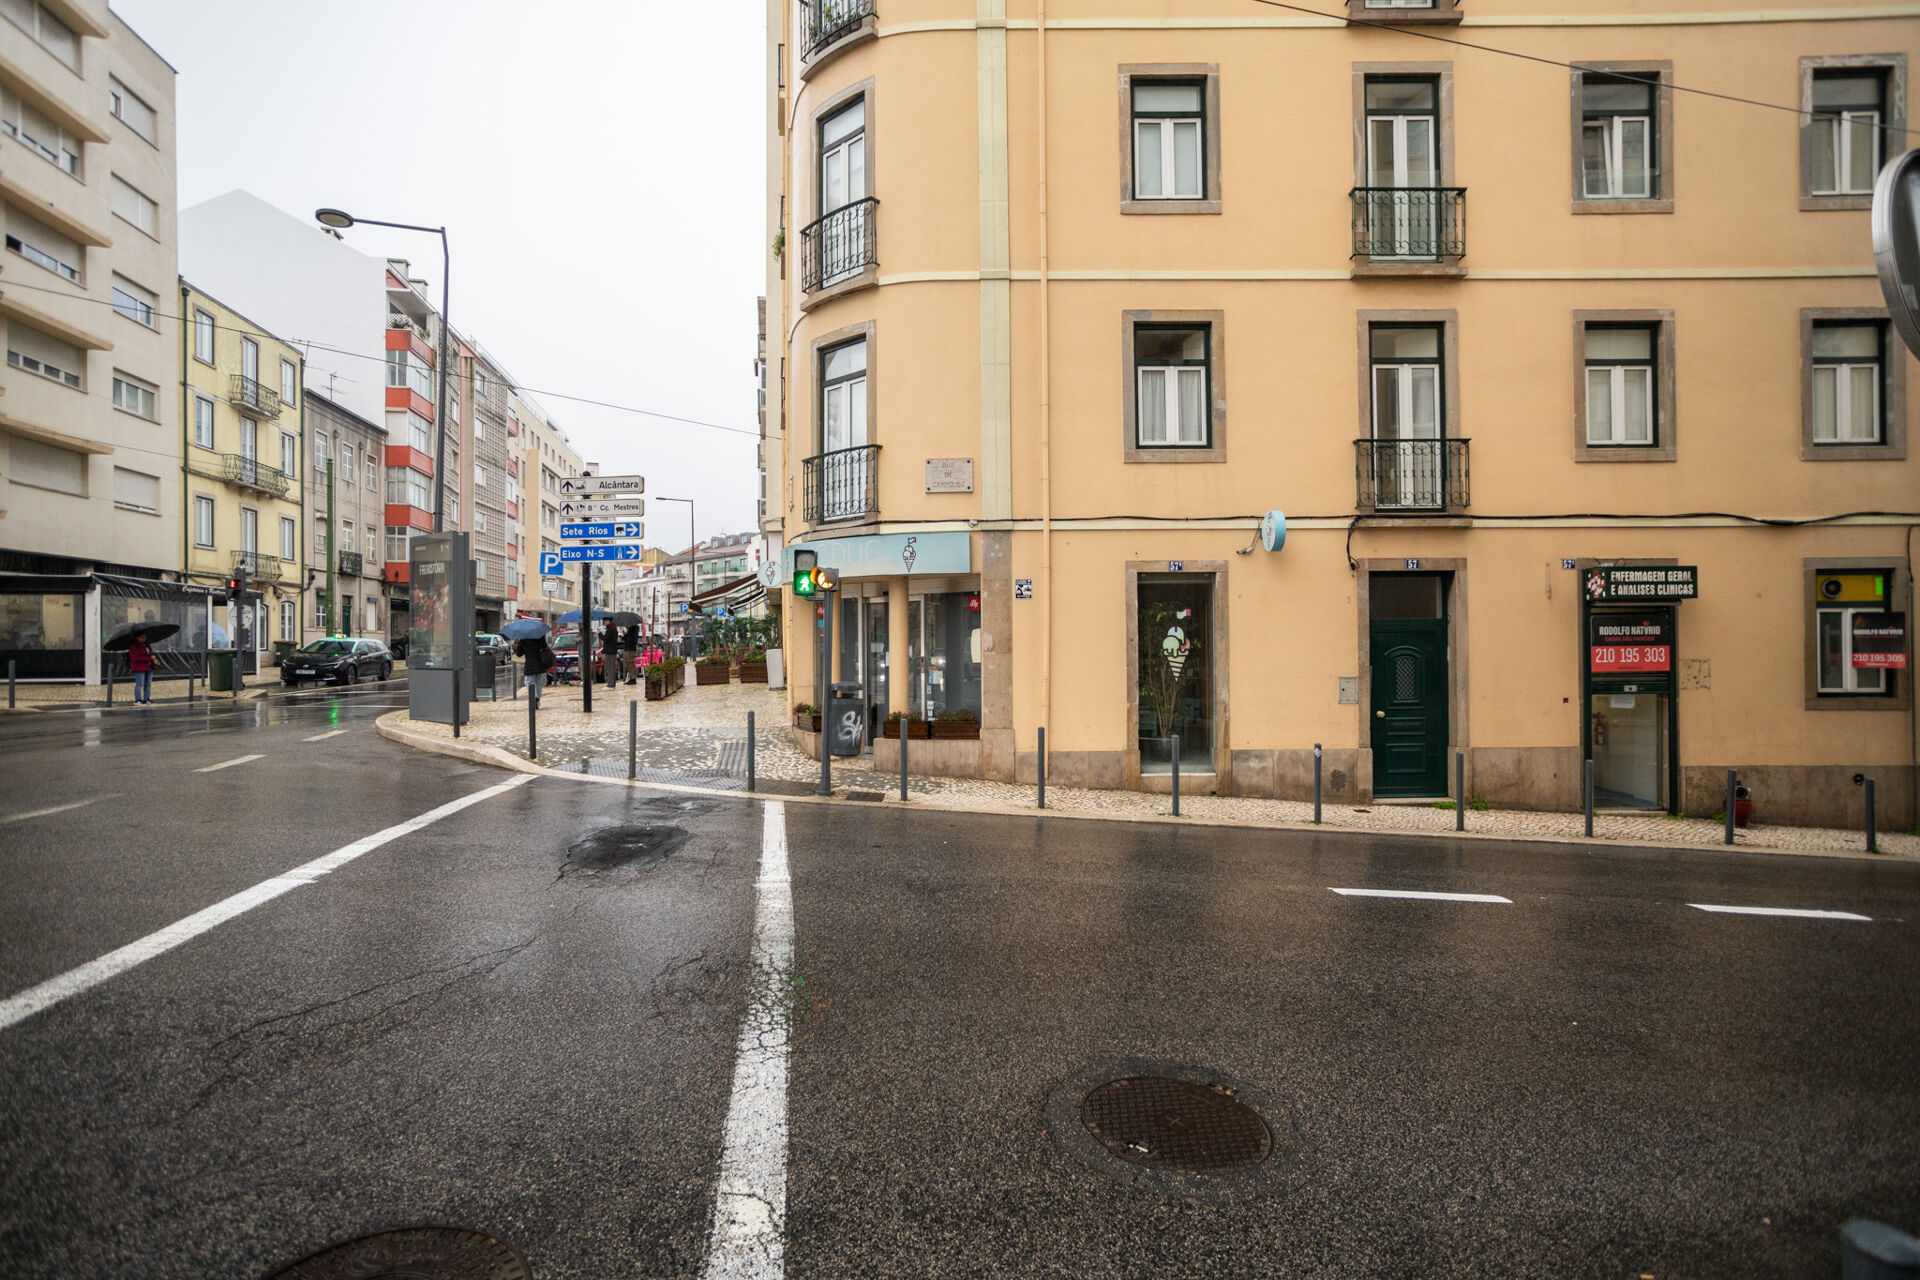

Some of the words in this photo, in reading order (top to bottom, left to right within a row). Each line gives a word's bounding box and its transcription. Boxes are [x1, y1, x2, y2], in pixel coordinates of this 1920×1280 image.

[599, 480, 639, 490] Alcântara
[614, 503, 639, 511] Mestres
[562, 527, 583, 536] Sete
[588, 526, 608, 535] Rios
[562, 549, 581, 559] Eixo
[586, 549, 605, 558] N-S
[544, 553, 559, 573] P
[1610, 571, 1666, 582] ENFERMAGEM
[1667, 570, 1693, 581] GERAL
[1610, 585, 1616, 595] E
[1657, 584, 1694, 595] CLINICAS
[1599, 626, 1630, 636] RODOLFO
[1595, 648, 1615, 663] 210
[1619, 648, 1640, 663] 195
[1644, 647, 1666, 663] 303
